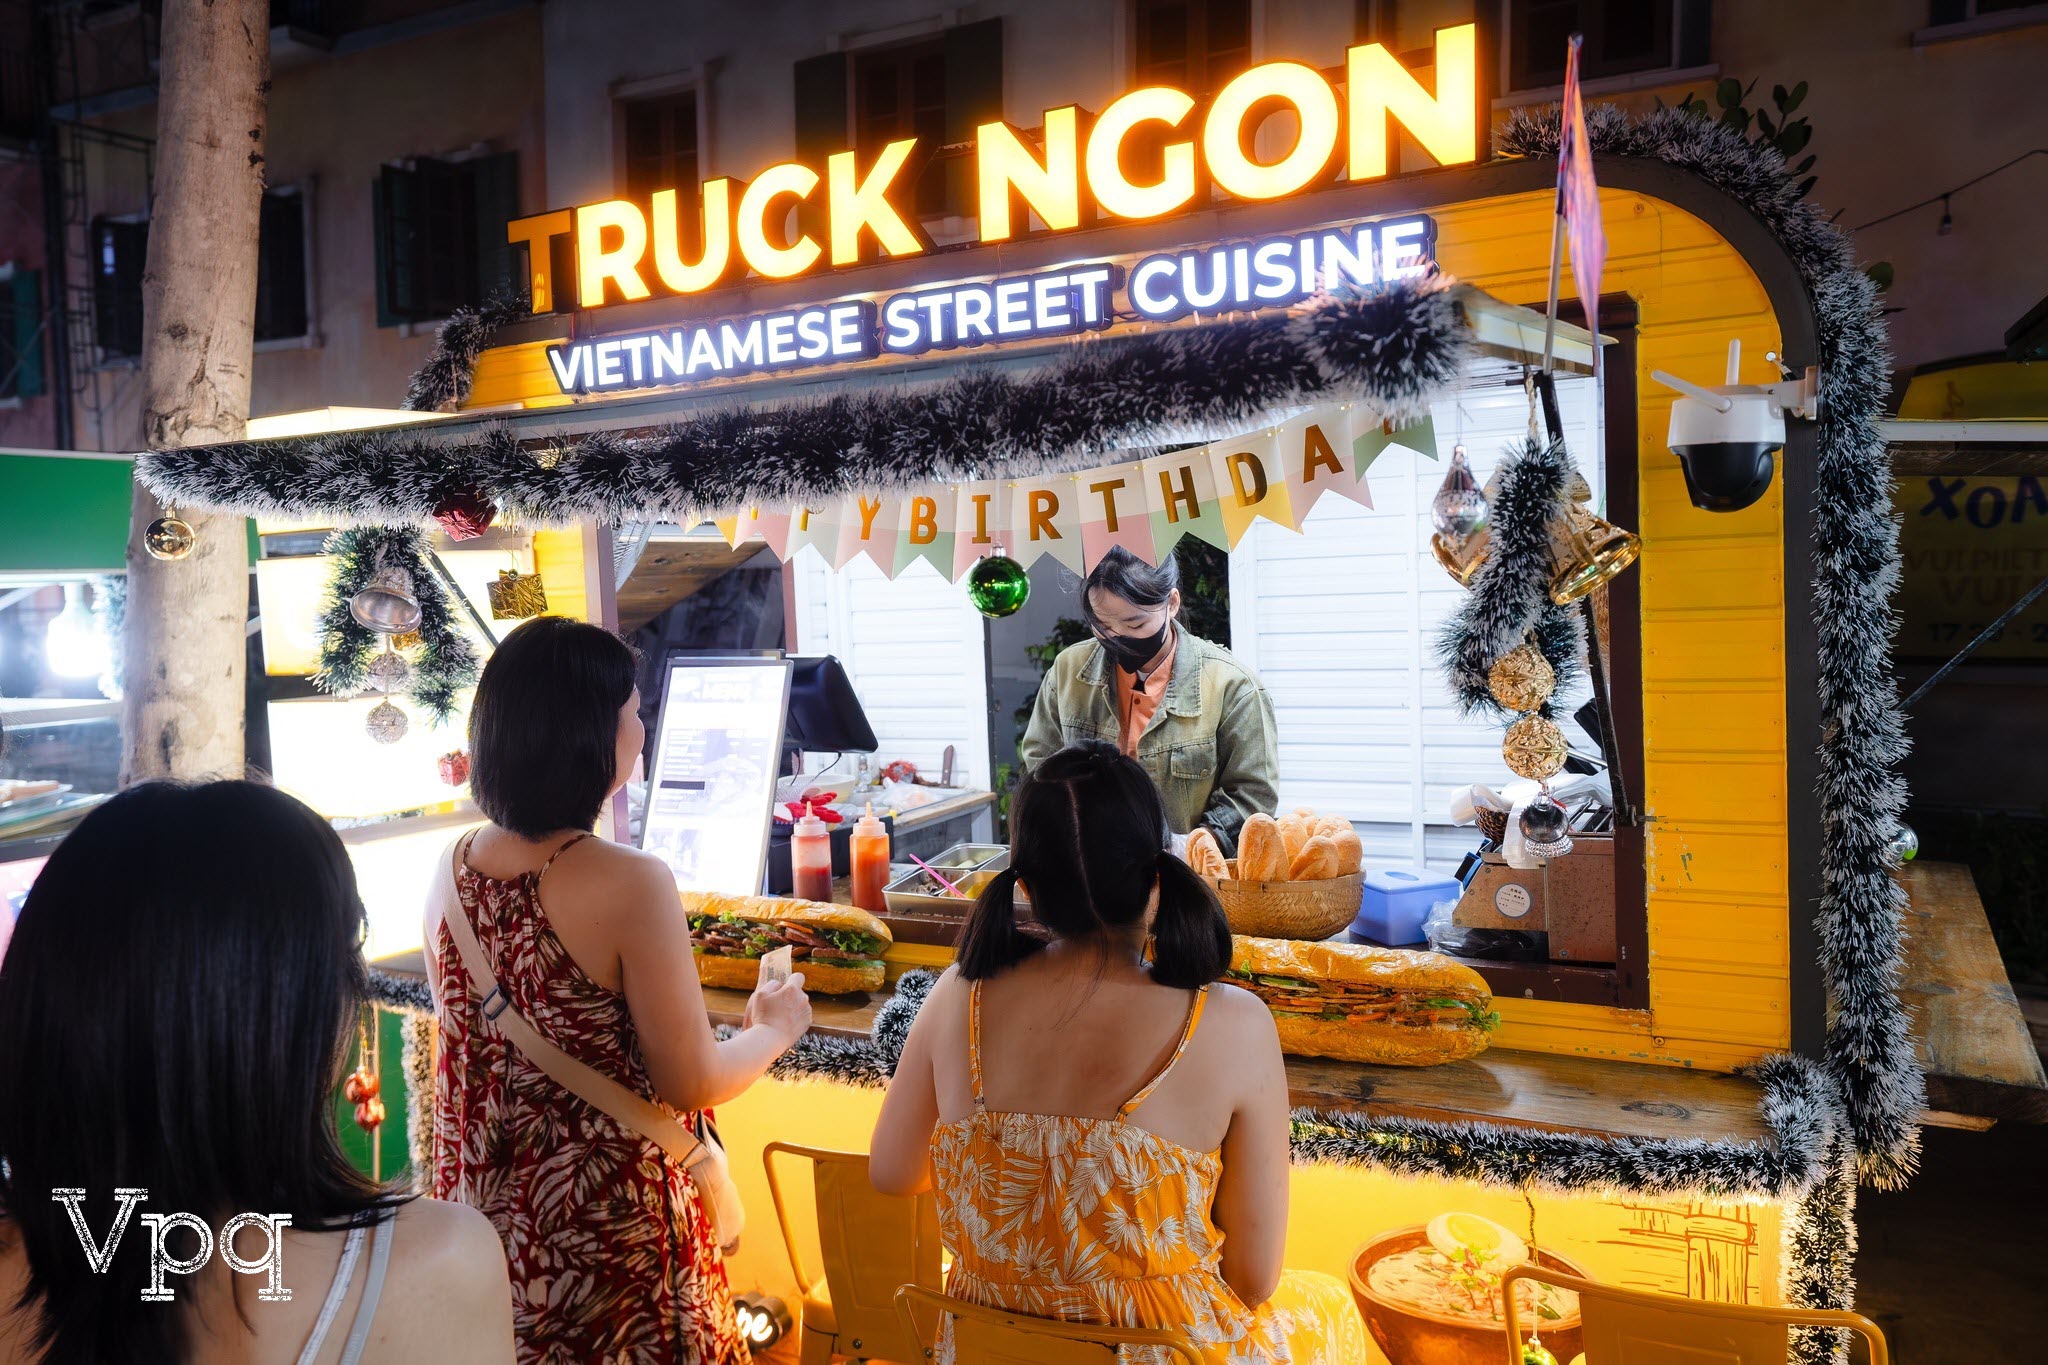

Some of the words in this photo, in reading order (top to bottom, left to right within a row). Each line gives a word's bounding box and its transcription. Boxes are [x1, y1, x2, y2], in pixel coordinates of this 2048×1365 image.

[507, 138, 924, 315] TRUCK
[976, 22, 1477, 243] NGON
[550, 306, 862, 390] VIETNAMESE
[885, 270, 1110, 349] STREET
[1133, 221, 1426, 315] CUISINE
[909, 417, 1398, 546] BIRTHDA
